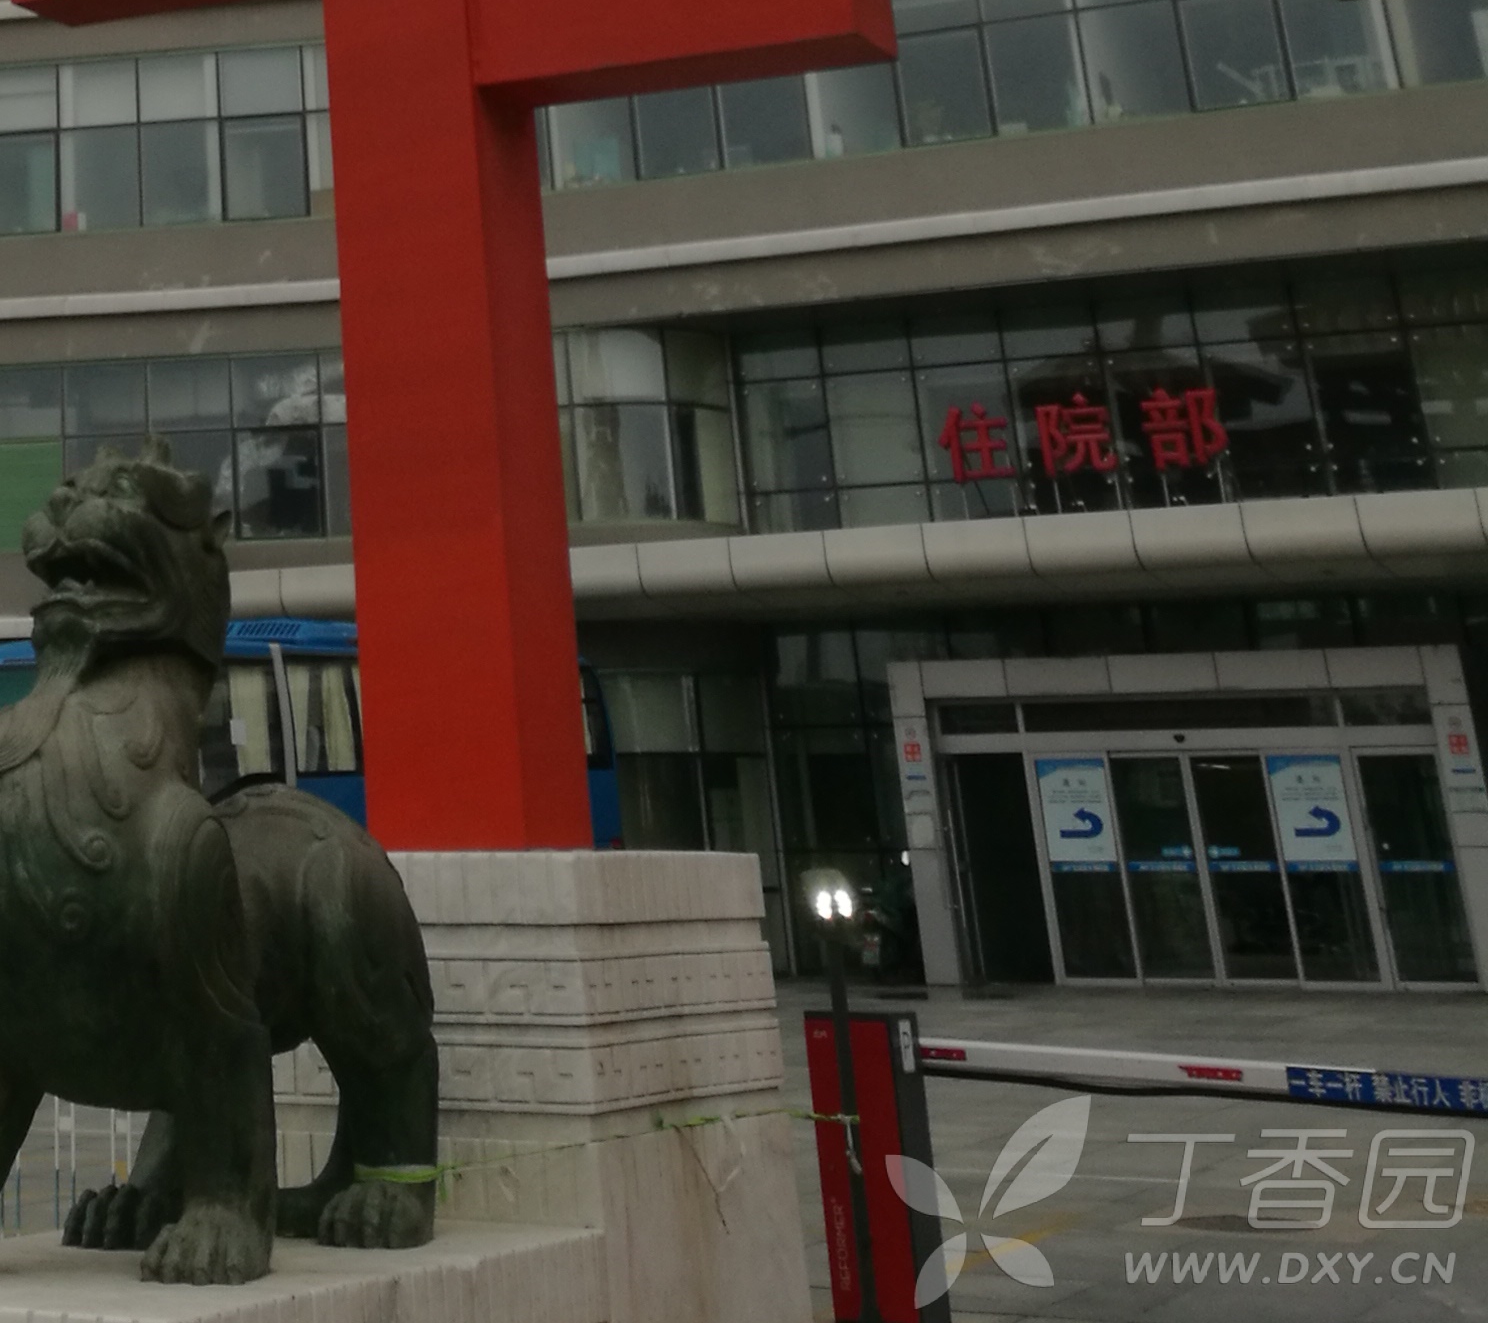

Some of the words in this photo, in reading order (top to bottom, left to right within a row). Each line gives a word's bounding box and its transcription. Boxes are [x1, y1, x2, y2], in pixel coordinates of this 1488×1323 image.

[938, 386, 1230, 485] 住院部
[1289, 1069, 1363, 1101] 一车一杆
[1371, 1072, 1452, 1108] 禁止行人
